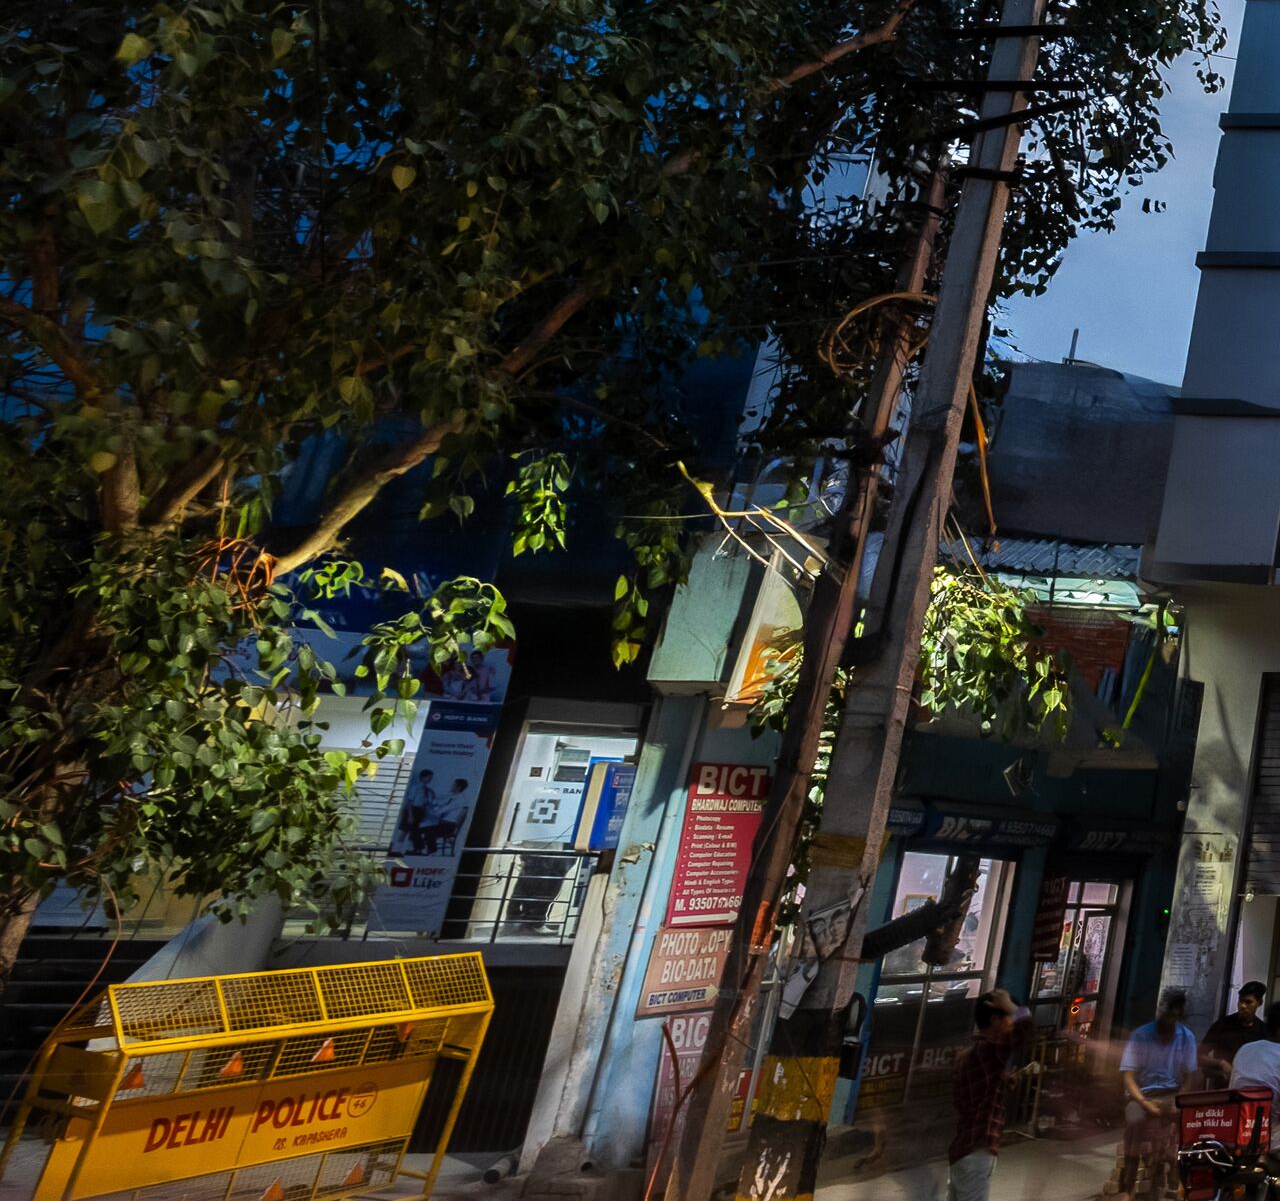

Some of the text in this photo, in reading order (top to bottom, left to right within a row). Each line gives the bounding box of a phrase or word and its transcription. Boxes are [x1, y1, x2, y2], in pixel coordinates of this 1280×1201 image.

[696, 765, 768, 797] BICT
[691, 799, 728, 812] BHARDWAJ
[412, 877, 442, 889] Life
[674, 899, 686, 911] M.
[658, 932, 700, 957] PHOTO
[660, 957, 717, 984] BIO-DATA
[648, 988, 706, 1006] BICT COMPUTER
[671, 1016, 711, 1049] BIC
[143, 1105, 236, 1154] DELHI
[251, 1086, 351, 1134] POLICE
[293, 1126, 348, 1148] KAPASHERA
